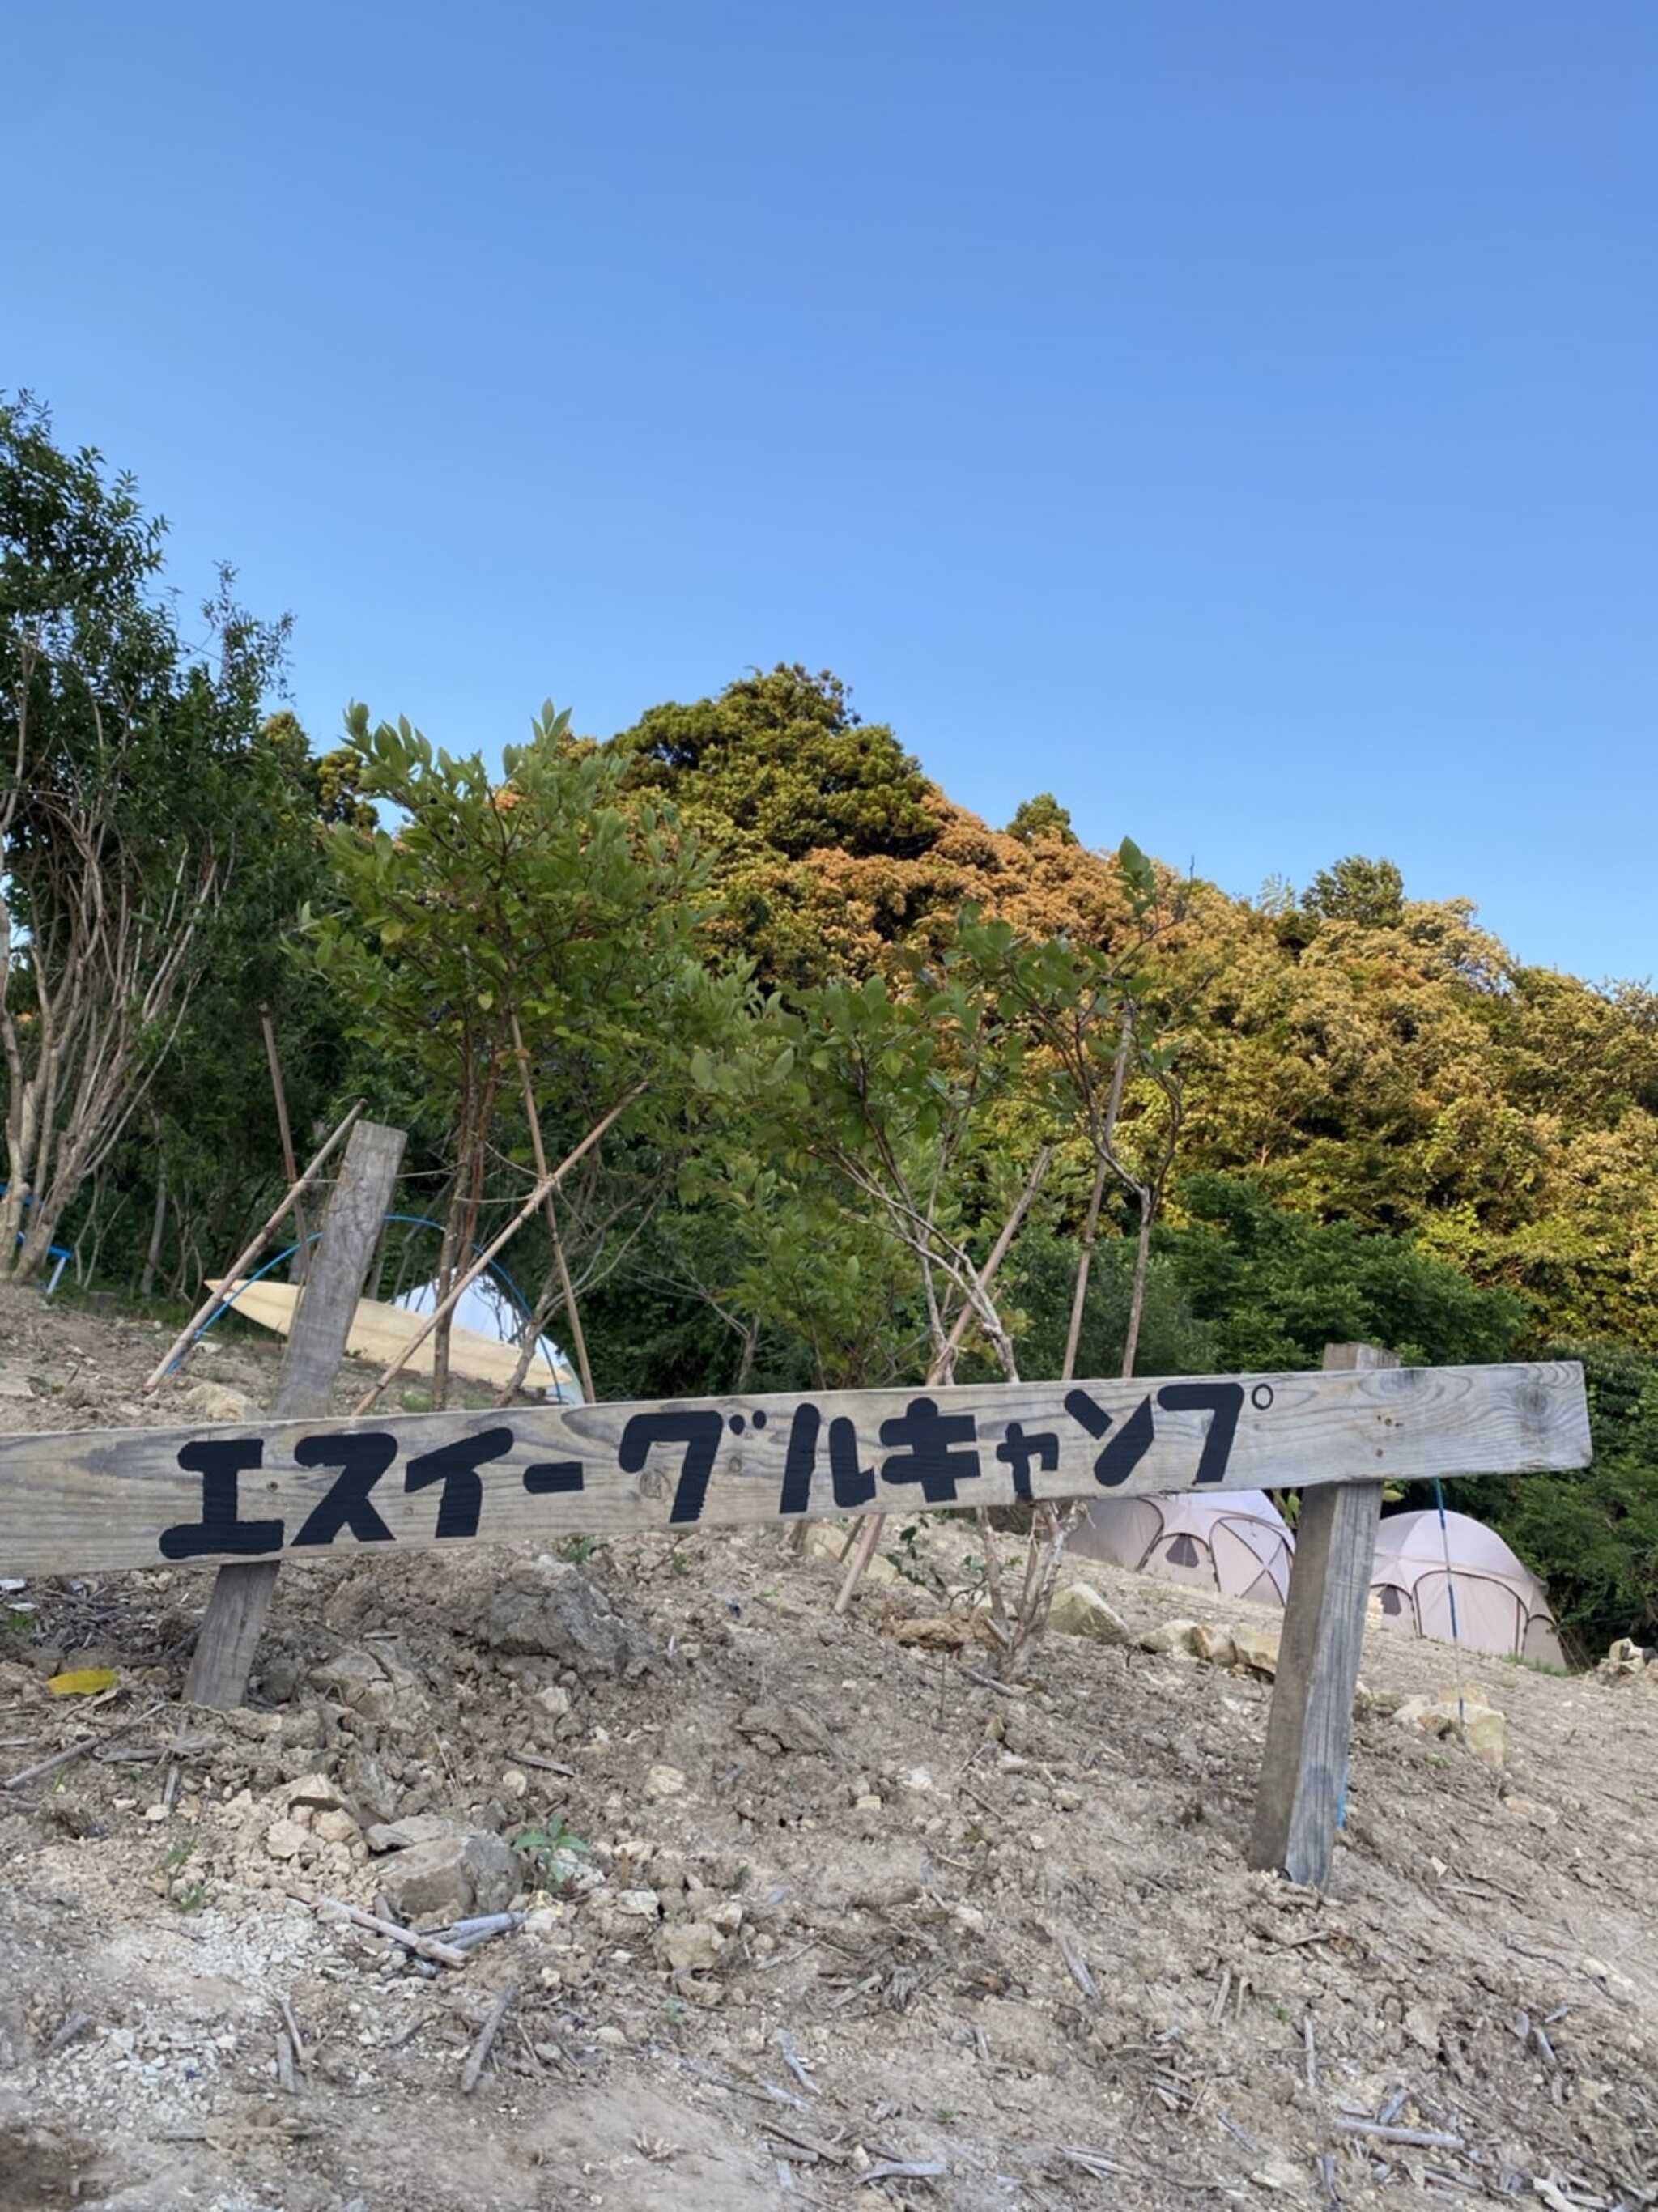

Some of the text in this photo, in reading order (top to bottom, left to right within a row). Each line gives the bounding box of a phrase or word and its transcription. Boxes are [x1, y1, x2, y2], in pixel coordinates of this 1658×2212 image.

[159, 1383, 1273, 1559] エスイーグルキャンプ
